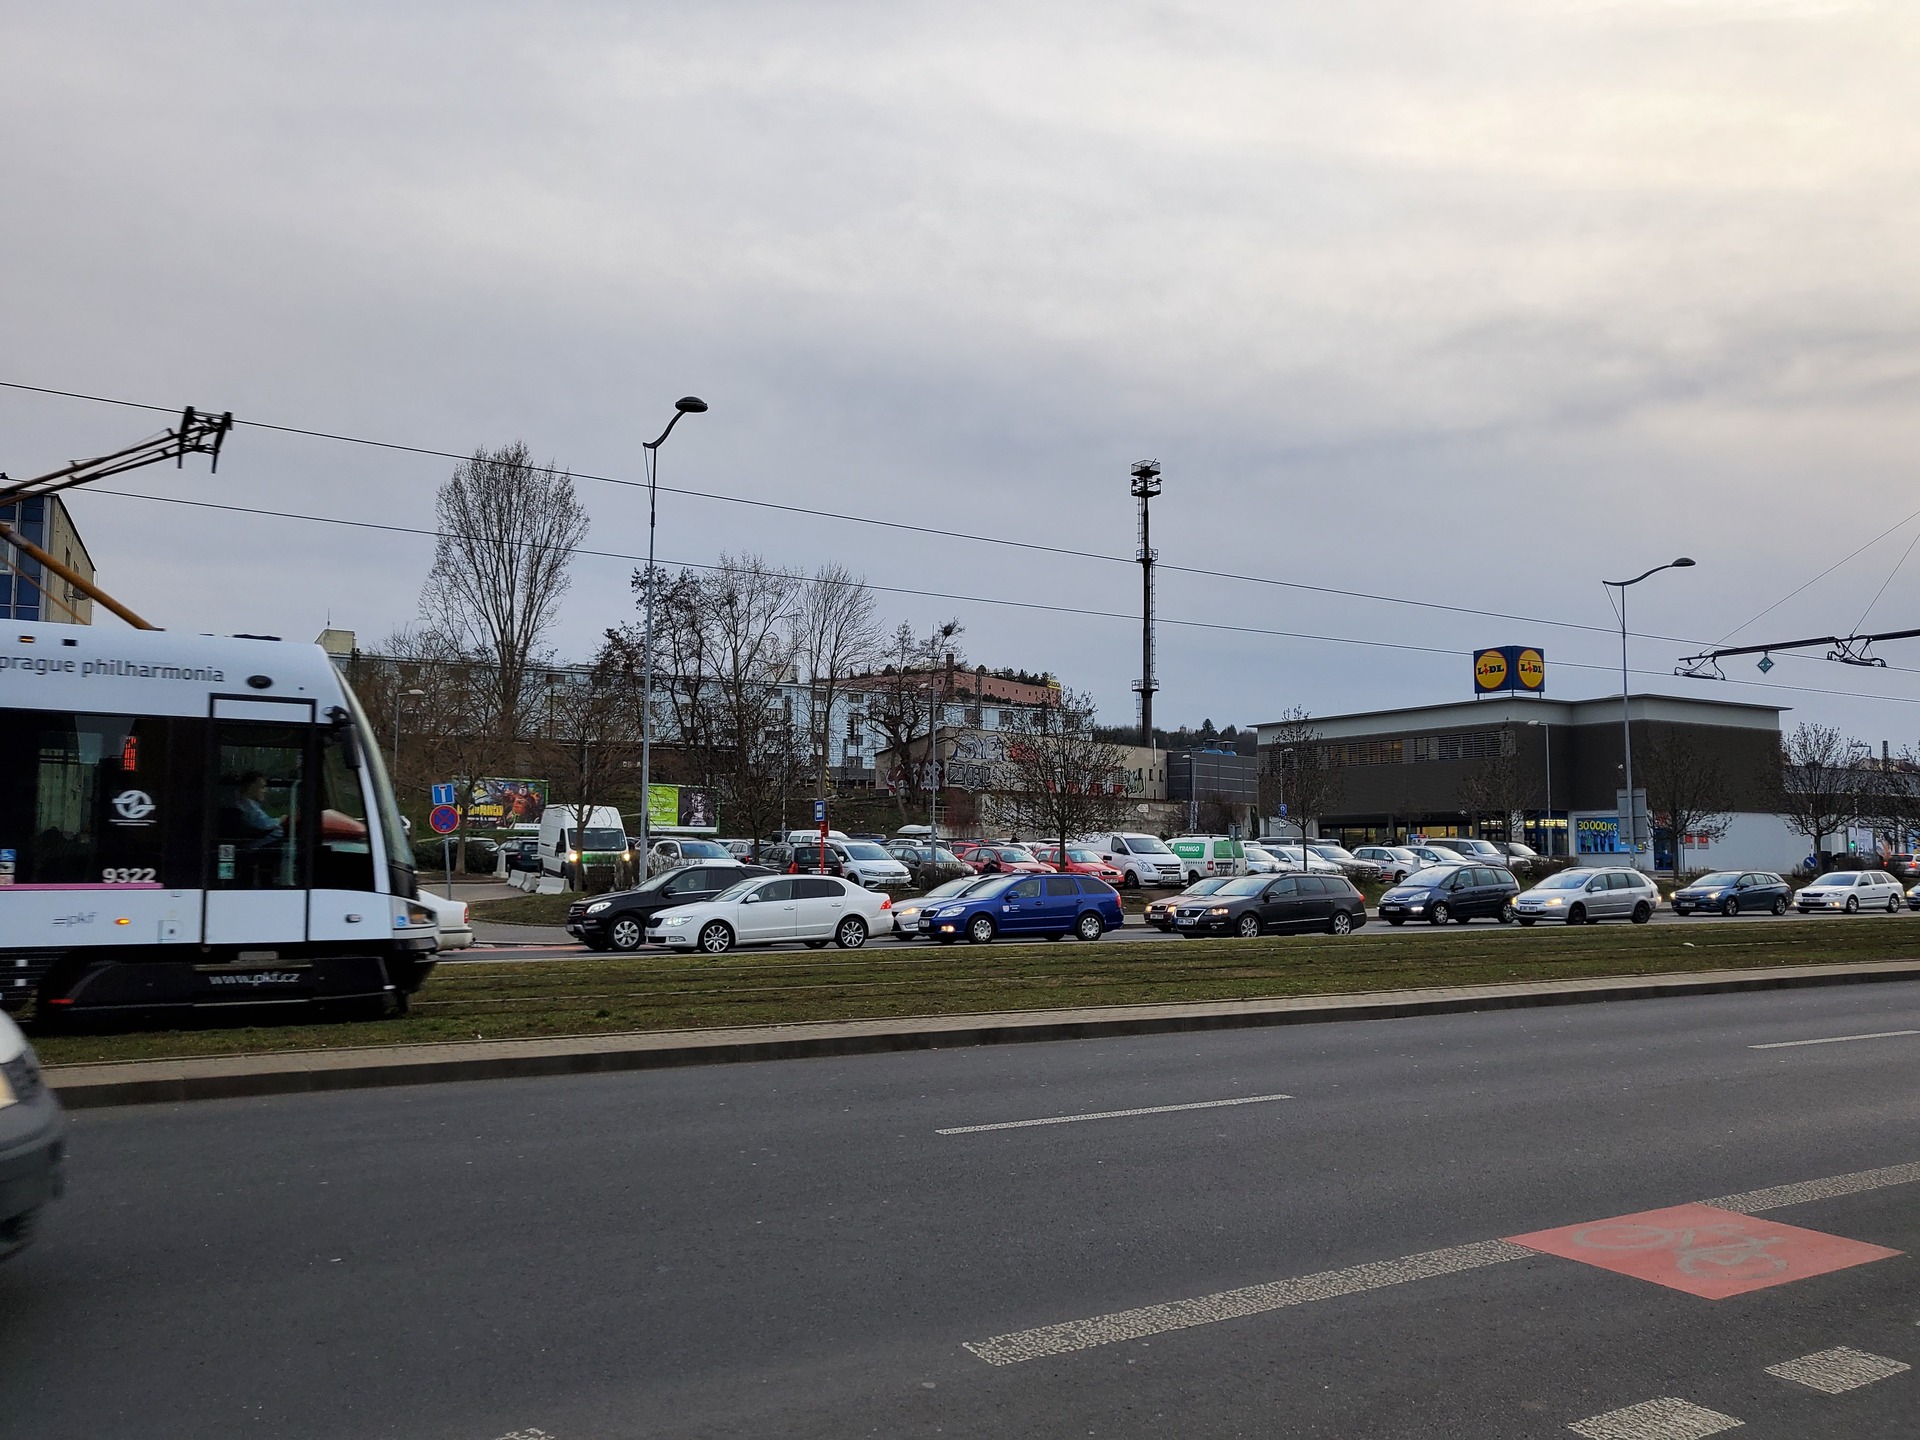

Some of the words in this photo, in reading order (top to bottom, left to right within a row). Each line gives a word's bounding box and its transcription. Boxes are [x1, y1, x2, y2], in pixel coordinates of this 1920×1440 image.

[0, 656, 76, 675] prague
[82, 659, 225, 682] philharmonia
[102, 868, 156, 883] 9322
